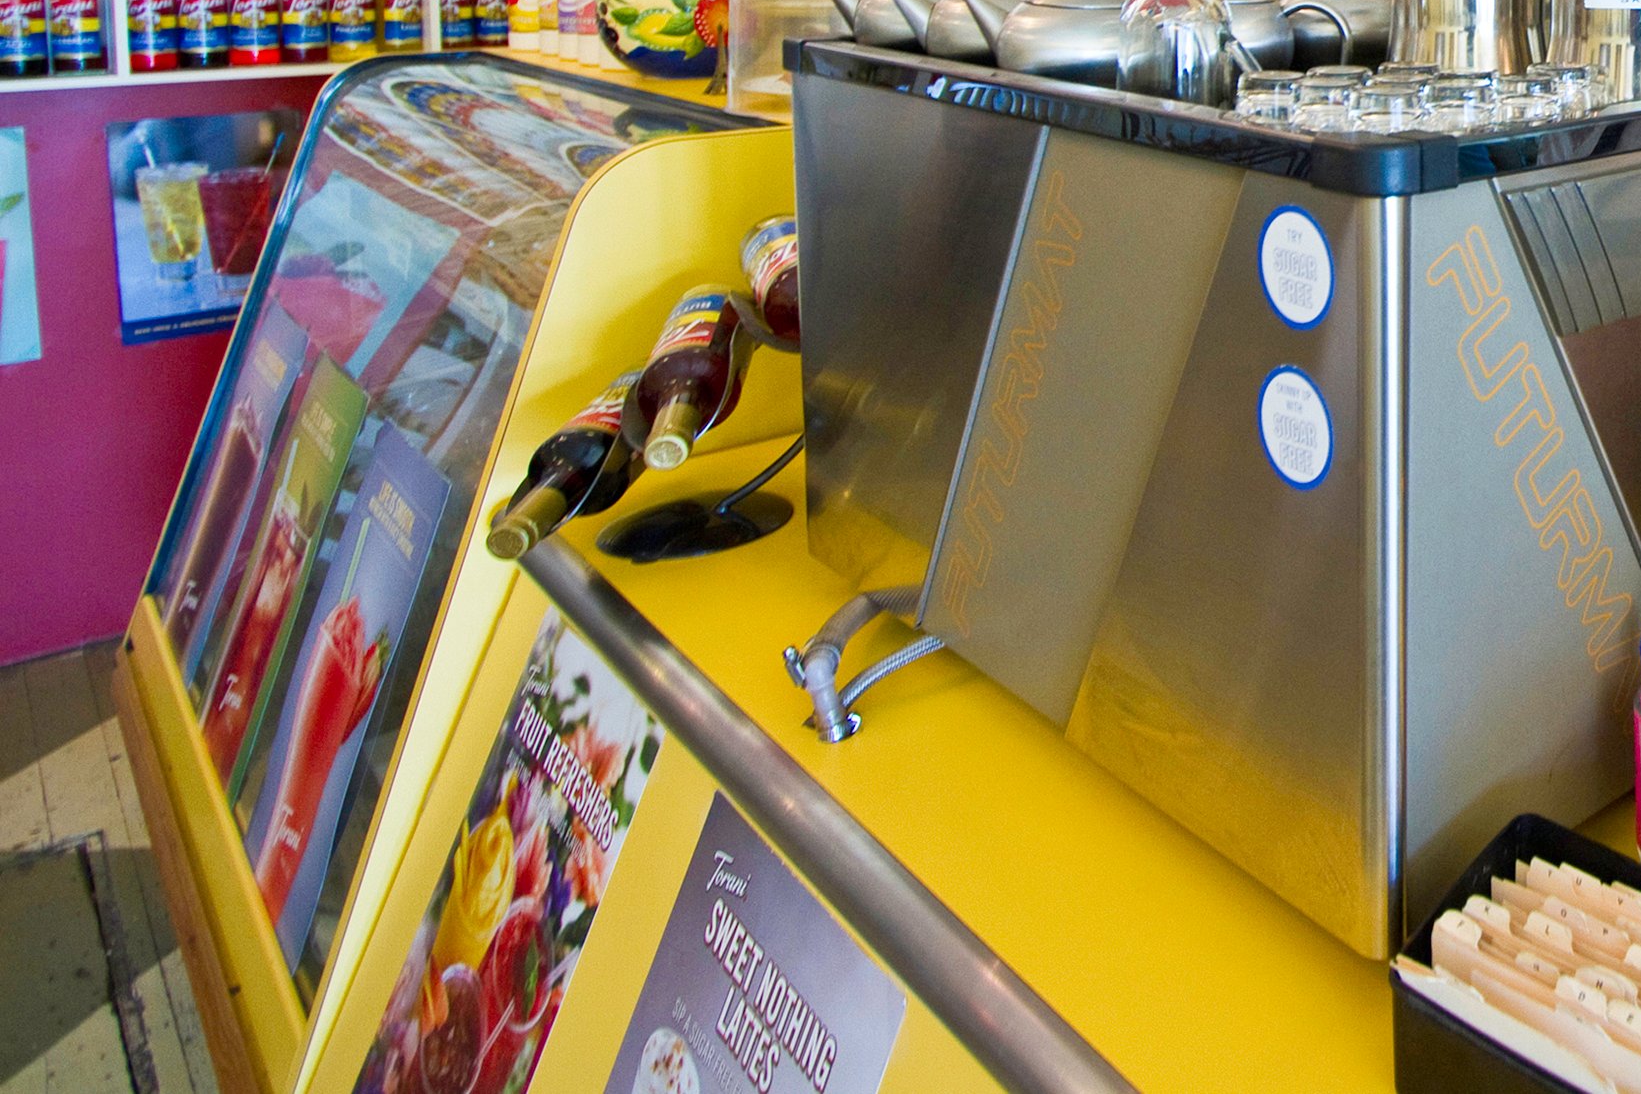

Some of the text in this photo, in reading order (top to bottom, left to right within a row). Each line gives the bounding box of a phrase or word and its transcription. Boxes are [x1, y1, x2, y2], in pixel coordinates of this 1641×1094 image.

[1286, 228, 1304, 243] TRY
[1272, 245, 1318, 282] SUGAR
[1277, 276, 1313, 309] FREE
[1272, 411, 1318, 449] SUGAR
[1278, 441, 1314, 477] FREE
[514, 698, 553, 761] FRUIT
[543, 732, 620, 852] REFRESHERS
[705, 849, 752, 899] Torani
[703, 897, 838, 1094] SWEET NOTHING
[714, 984, 780, 1094] LATTES
